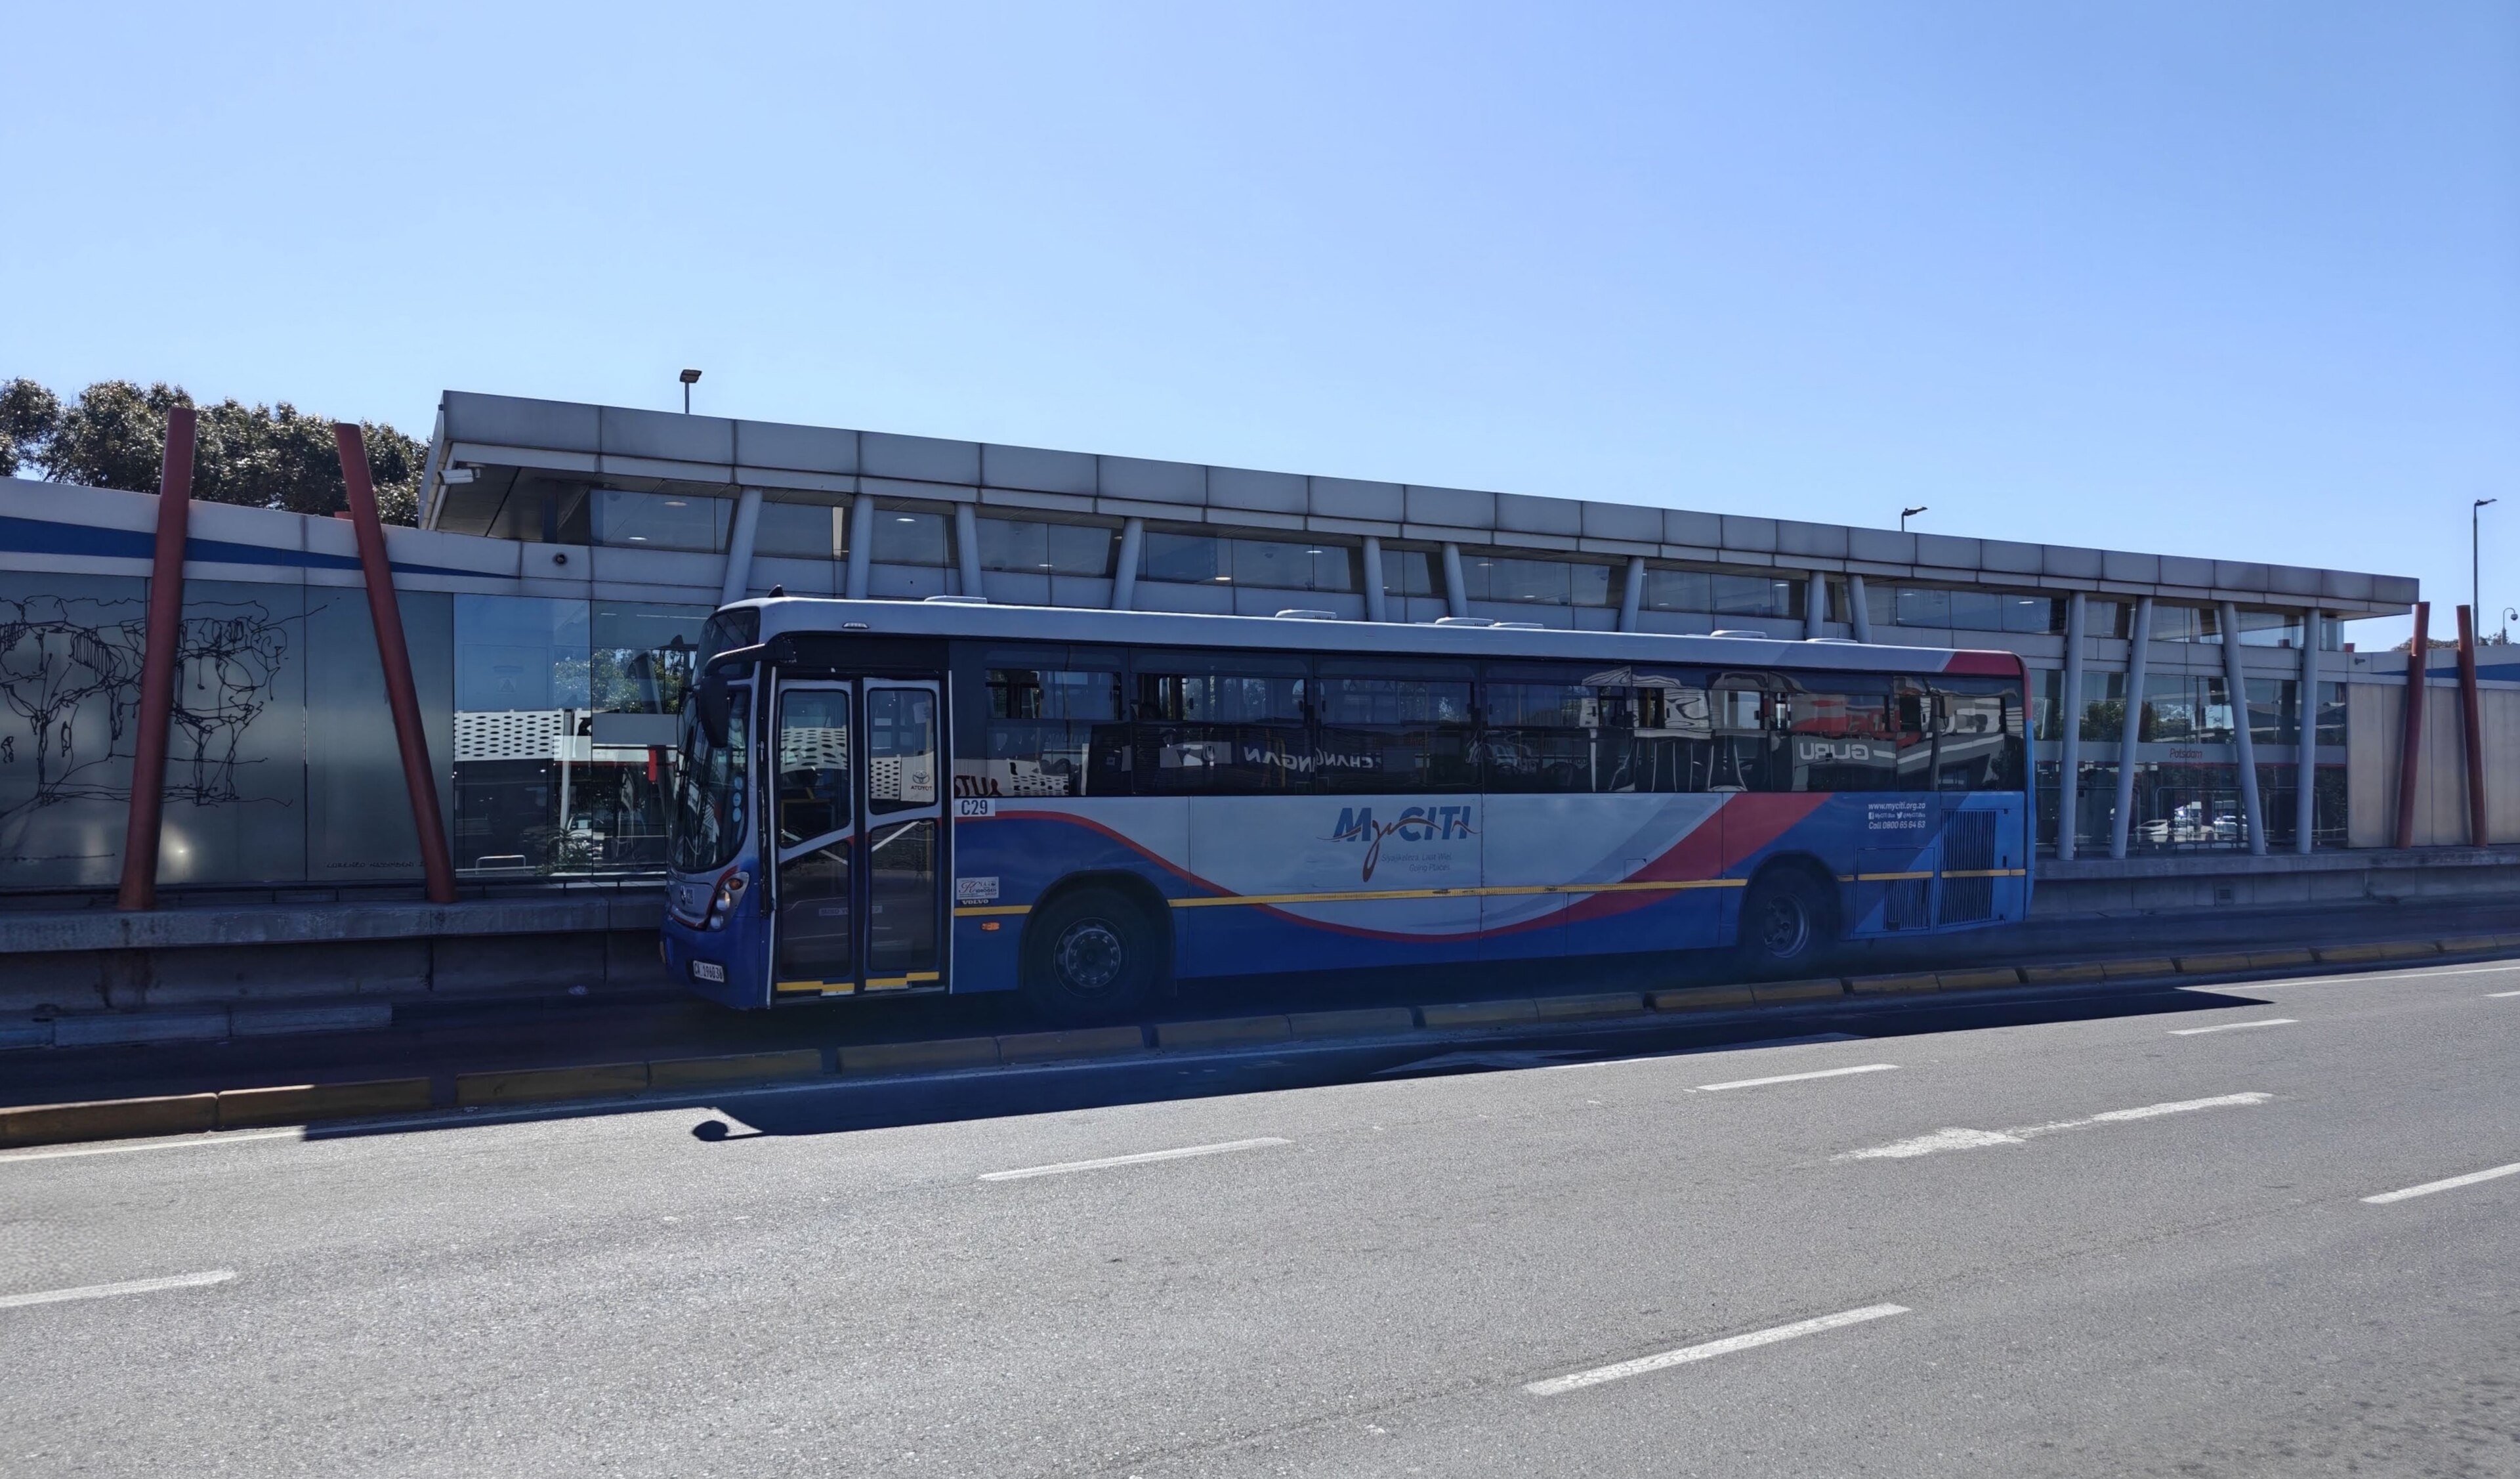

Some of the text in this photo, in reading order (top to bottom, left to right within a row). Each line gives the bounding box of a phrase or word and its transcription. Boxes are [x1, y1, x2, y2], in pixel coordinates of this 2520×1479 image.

[2170, 748, 2203, 759] Potsdam
[961, 800, 988, 815] C29
[694, 963, 700, 974] CA
